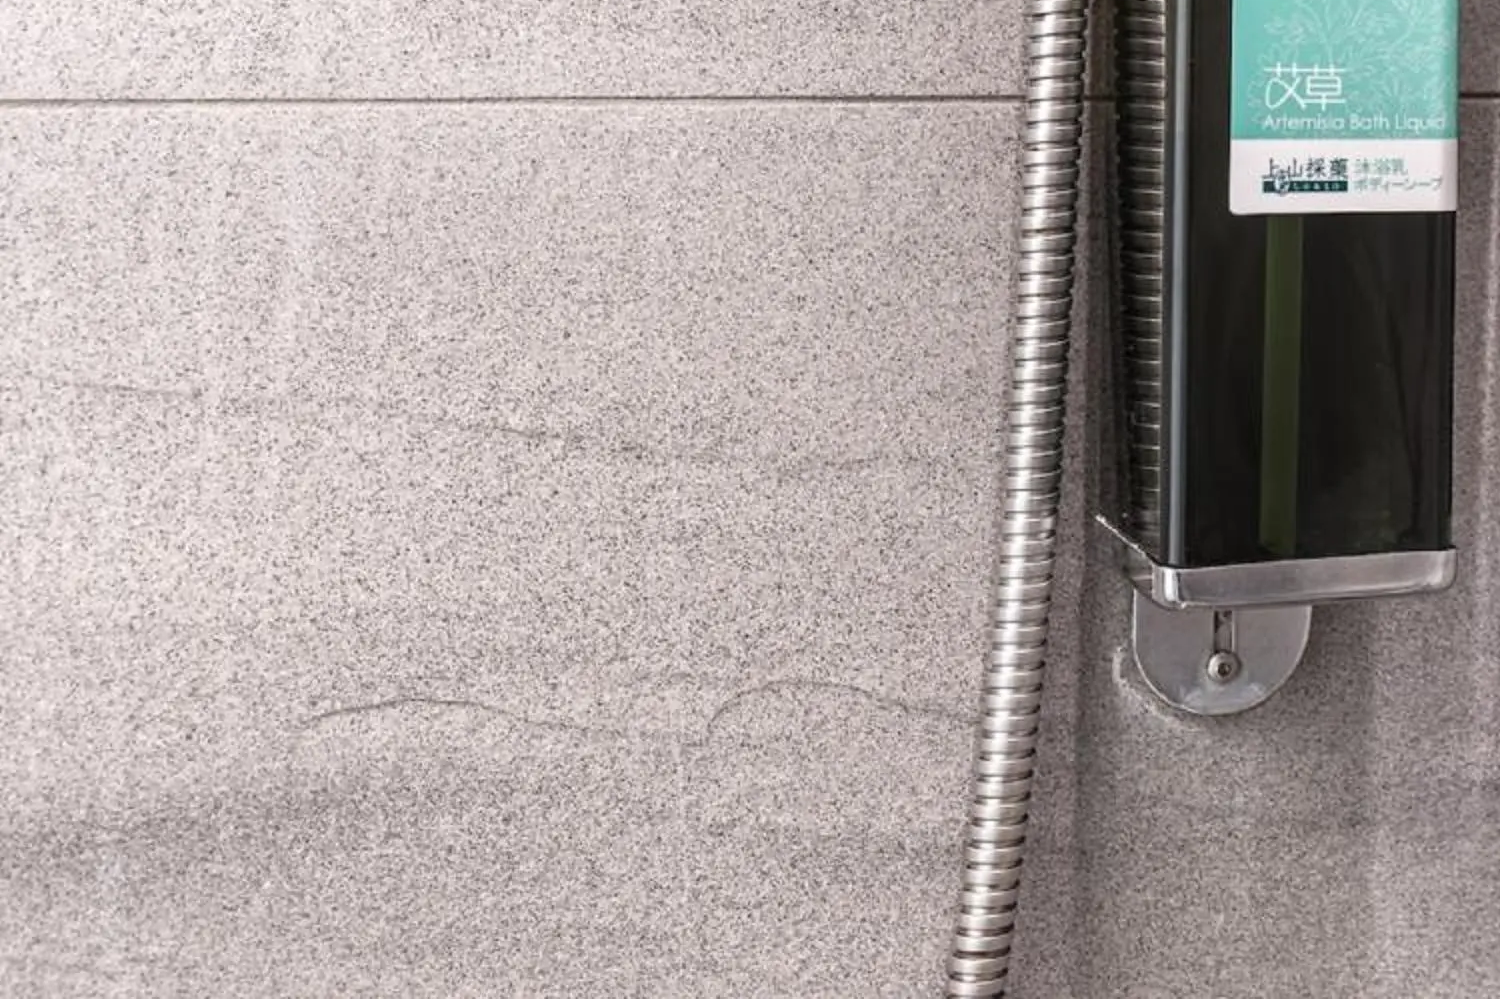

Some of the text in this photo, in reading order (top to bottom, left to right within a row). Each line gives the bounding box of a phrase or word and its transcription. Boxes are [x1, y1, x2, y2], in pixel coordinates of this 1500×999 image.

[1263, 61, 1346, 111] 艾草
[1262, 112, 1445, 134] Artemisia Bath Liquid
